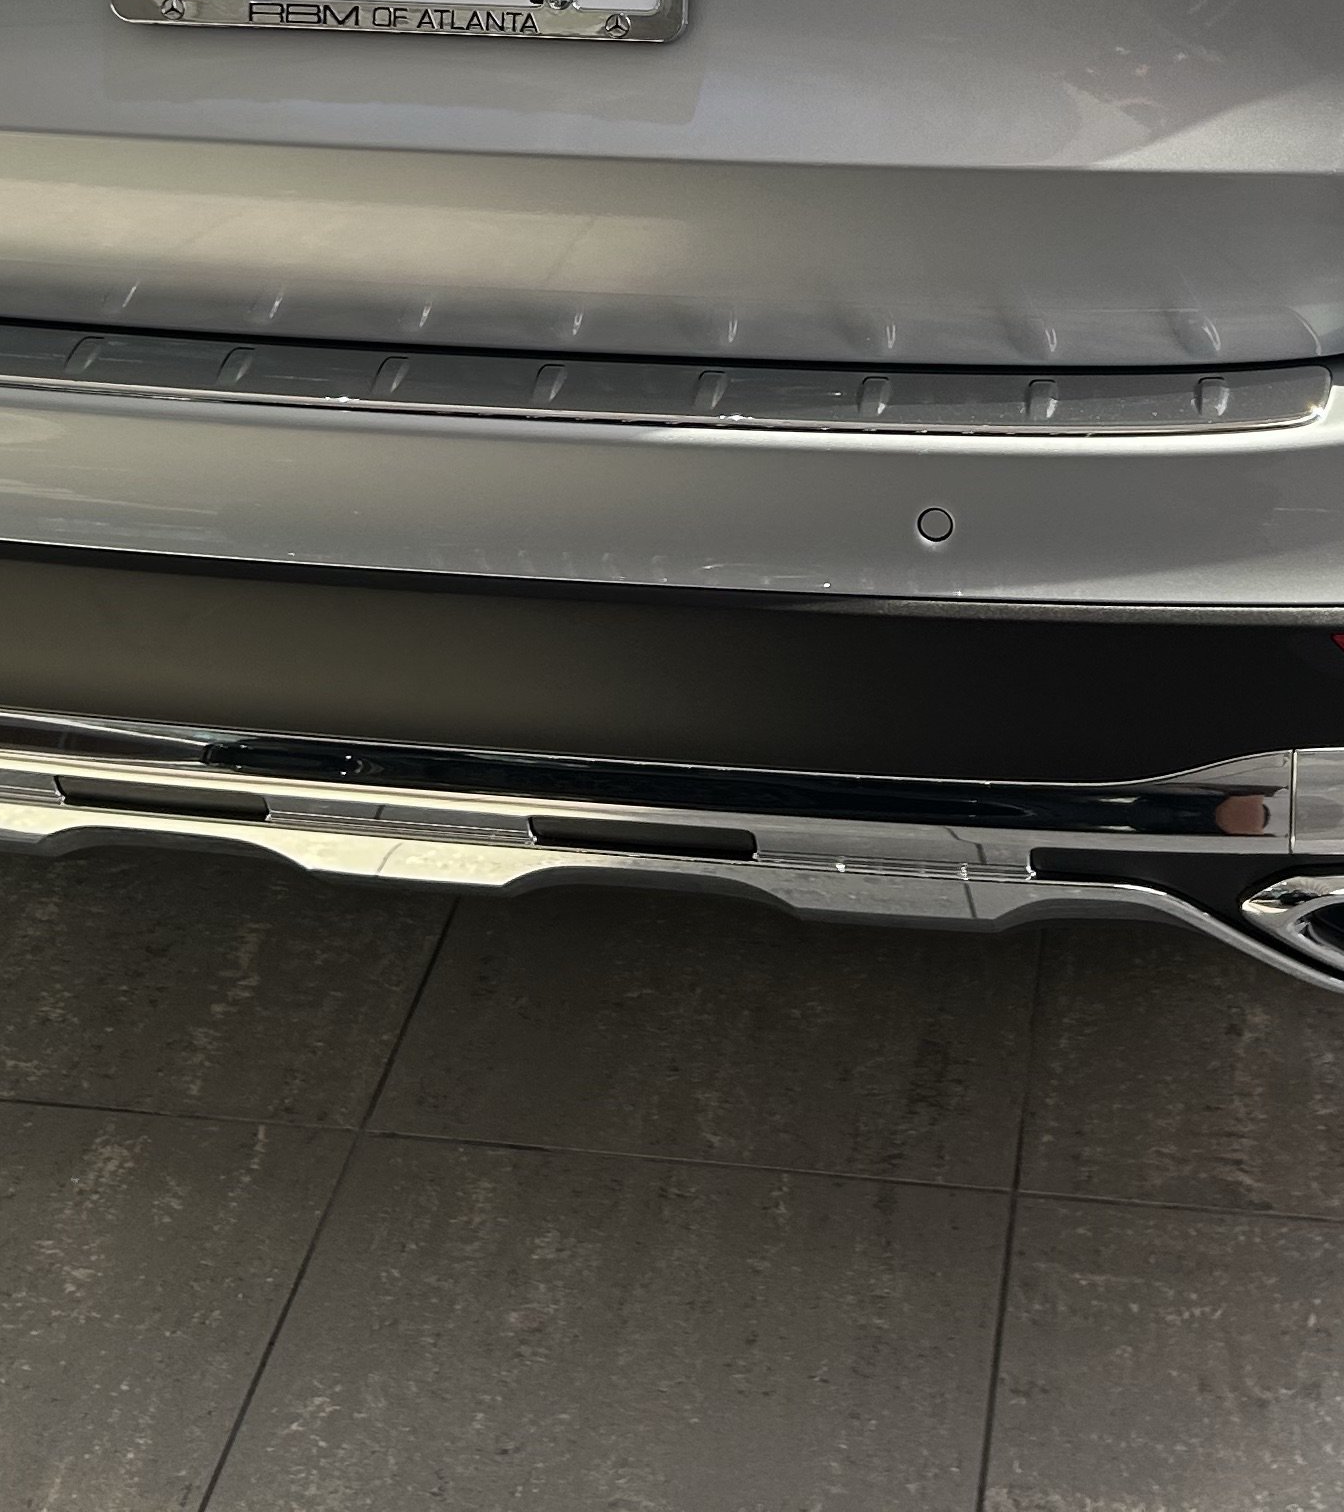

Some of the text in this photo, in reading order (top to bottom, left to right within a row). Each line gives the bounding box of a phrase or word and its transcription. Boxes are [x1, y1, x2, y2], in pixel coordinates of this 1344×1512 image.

[248, 2, 540, 35] RBM OF ATLANTA
